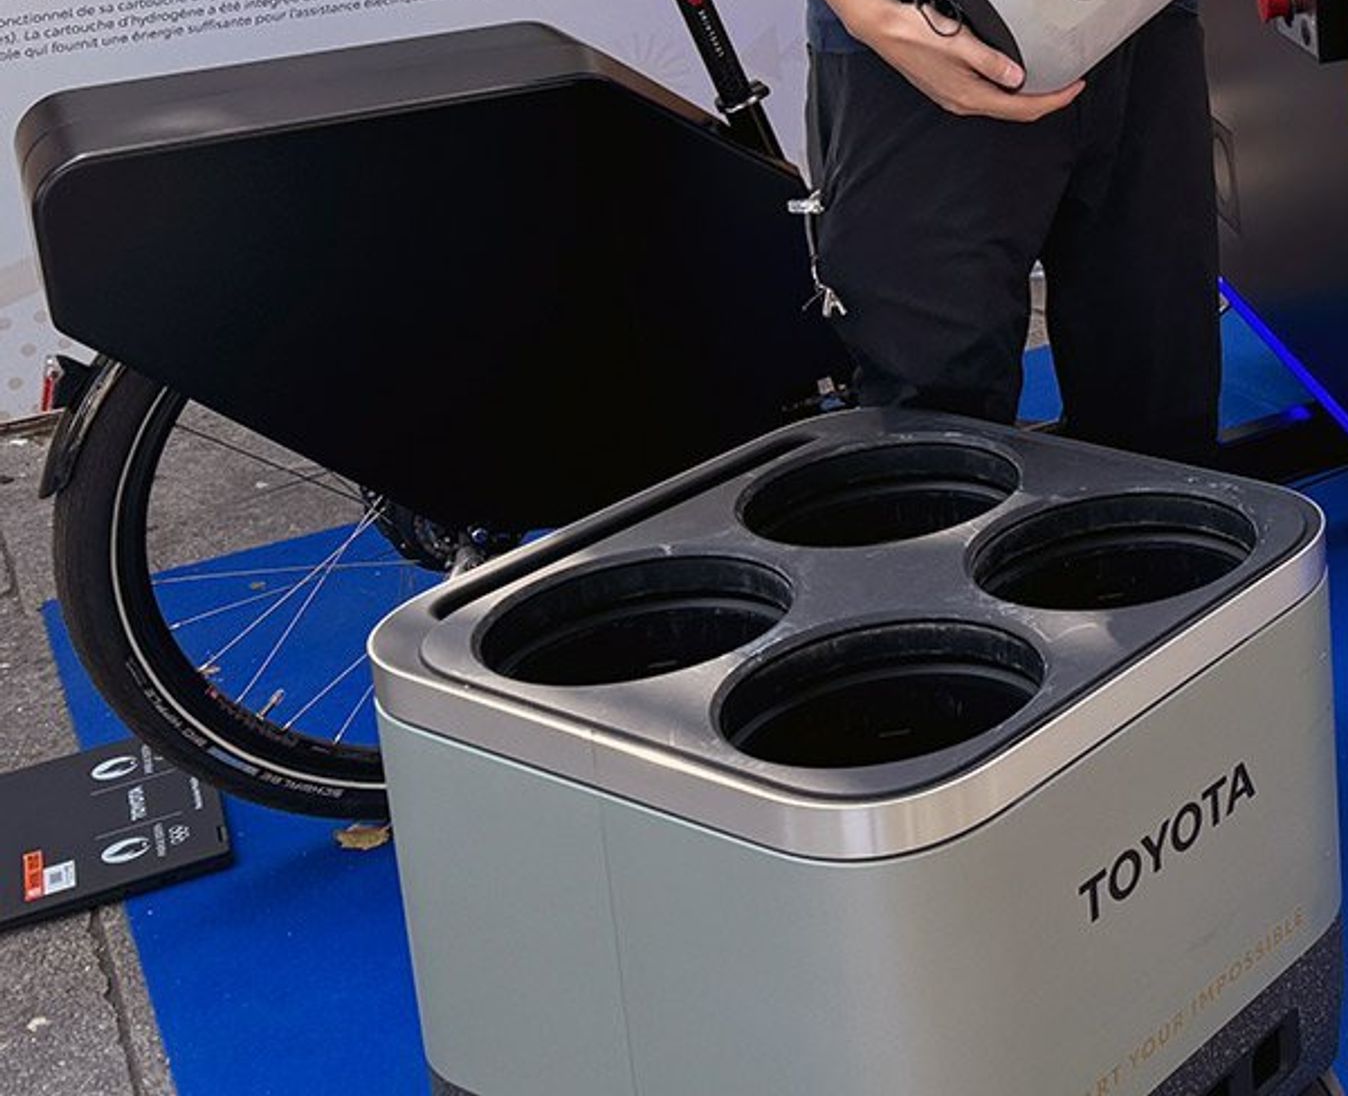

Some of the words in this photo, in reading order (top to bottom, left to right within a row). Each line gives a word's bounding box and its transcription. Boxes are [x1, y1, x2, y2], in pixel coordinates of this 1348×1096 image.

[24, 29, 40, 42] La
[43, 18, 116, 38] cartouche
[206, 5, 218, 16] a
[218, 1, 242, 13] été
[24, 44, 49, 59] qui
[51, 36, 100, 55] fournit
[101, 34, 129, 47] une
[131, 24, 185, 42] énergie
[186, 15, 253, 35] suffisante
[254, 10, 288, 26] pour
[76, 4, 96, 18] de
[98, 3, 115, 14] sa
[1077, 760, 1257, 924] TOYOTA
[1084, 1064, 1122, 1096] RT
[1127, 1008, 1186, 1068] YOUR
[1188, 904, 1307, 1019] IMPOSSIBLE
